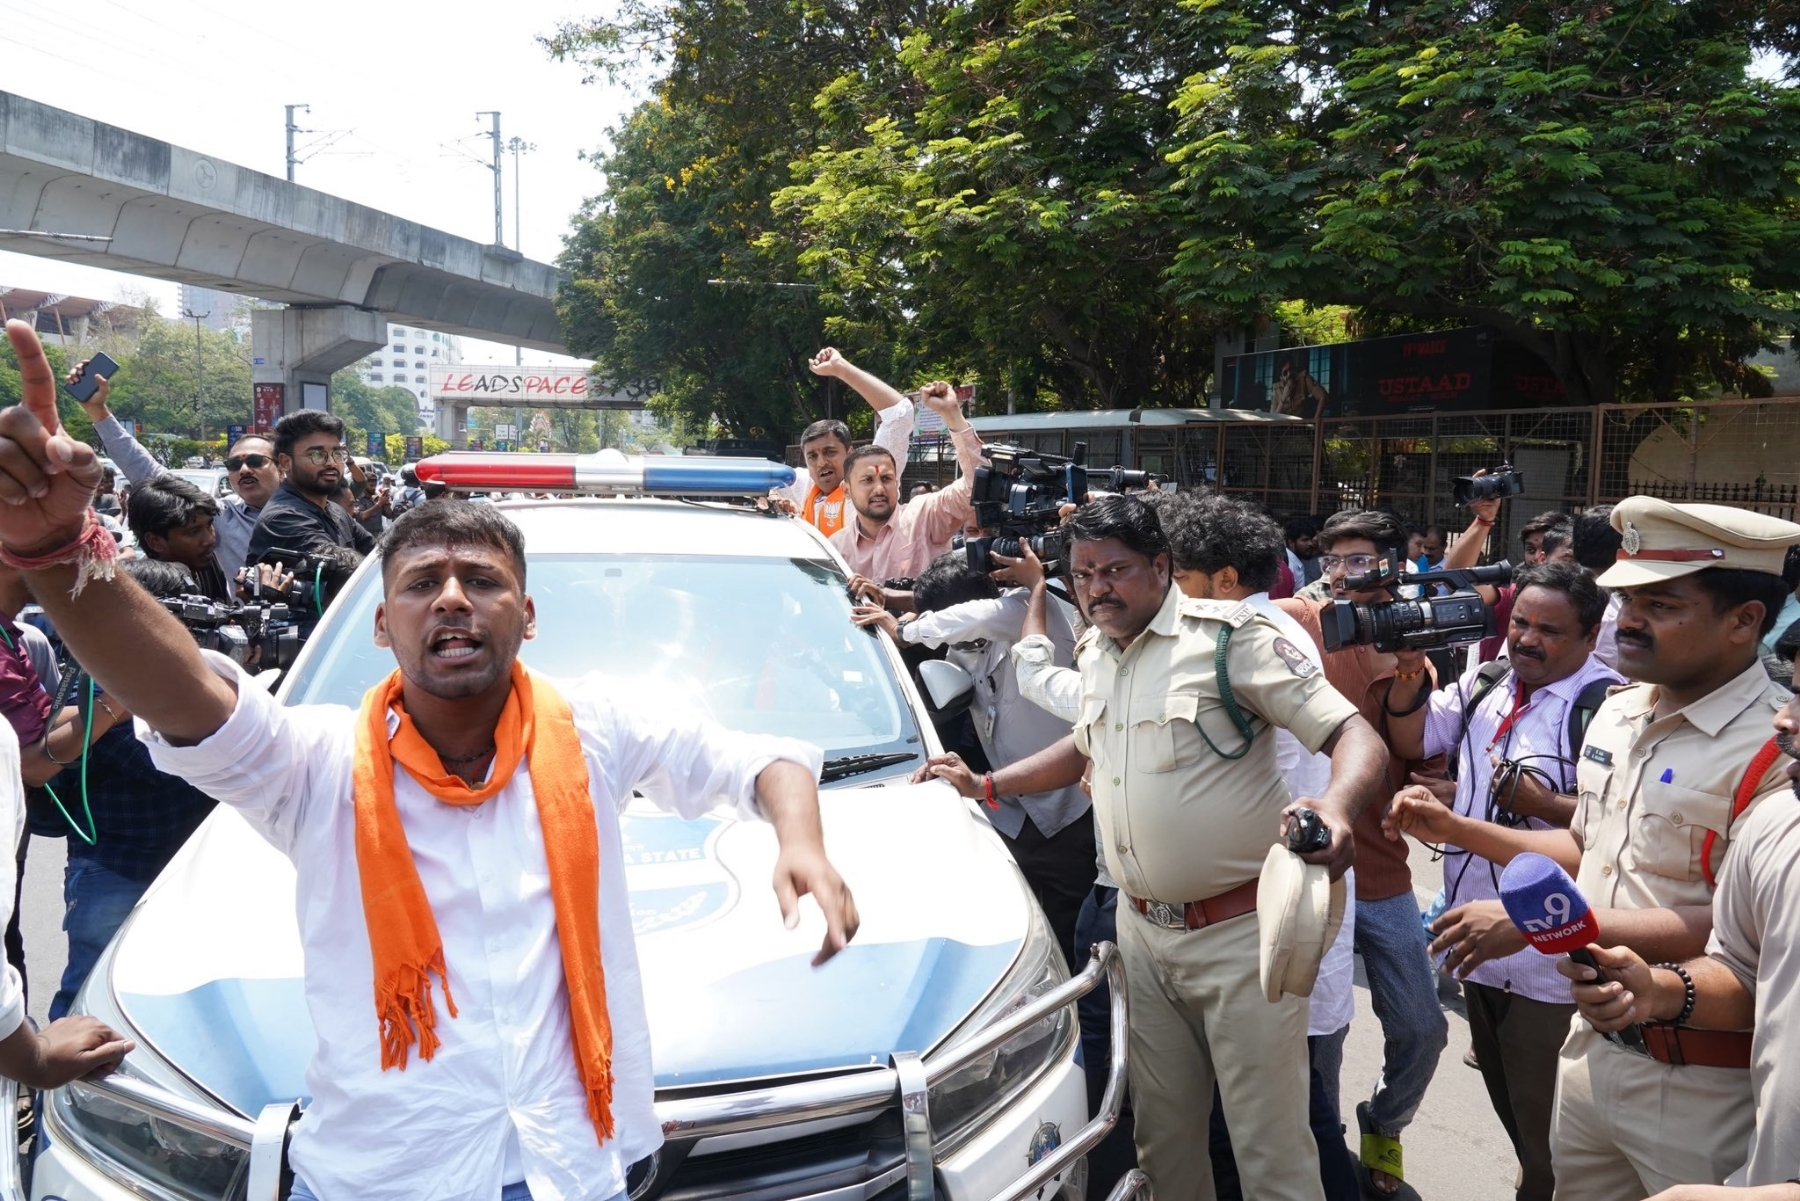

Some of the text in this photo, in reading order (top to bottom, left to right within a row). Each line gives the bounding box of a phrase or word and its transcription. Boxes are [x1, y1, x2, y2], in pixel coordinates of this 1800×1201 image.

[440, 373, 588, 394] LEADSPACE
[1379, 372, 1472, 395] USTAAD
[53, 667, 76, 709] Panasonic
[641, 848, 700, 862] STATE
[1532, 920, 1587, 943] NETWORK
